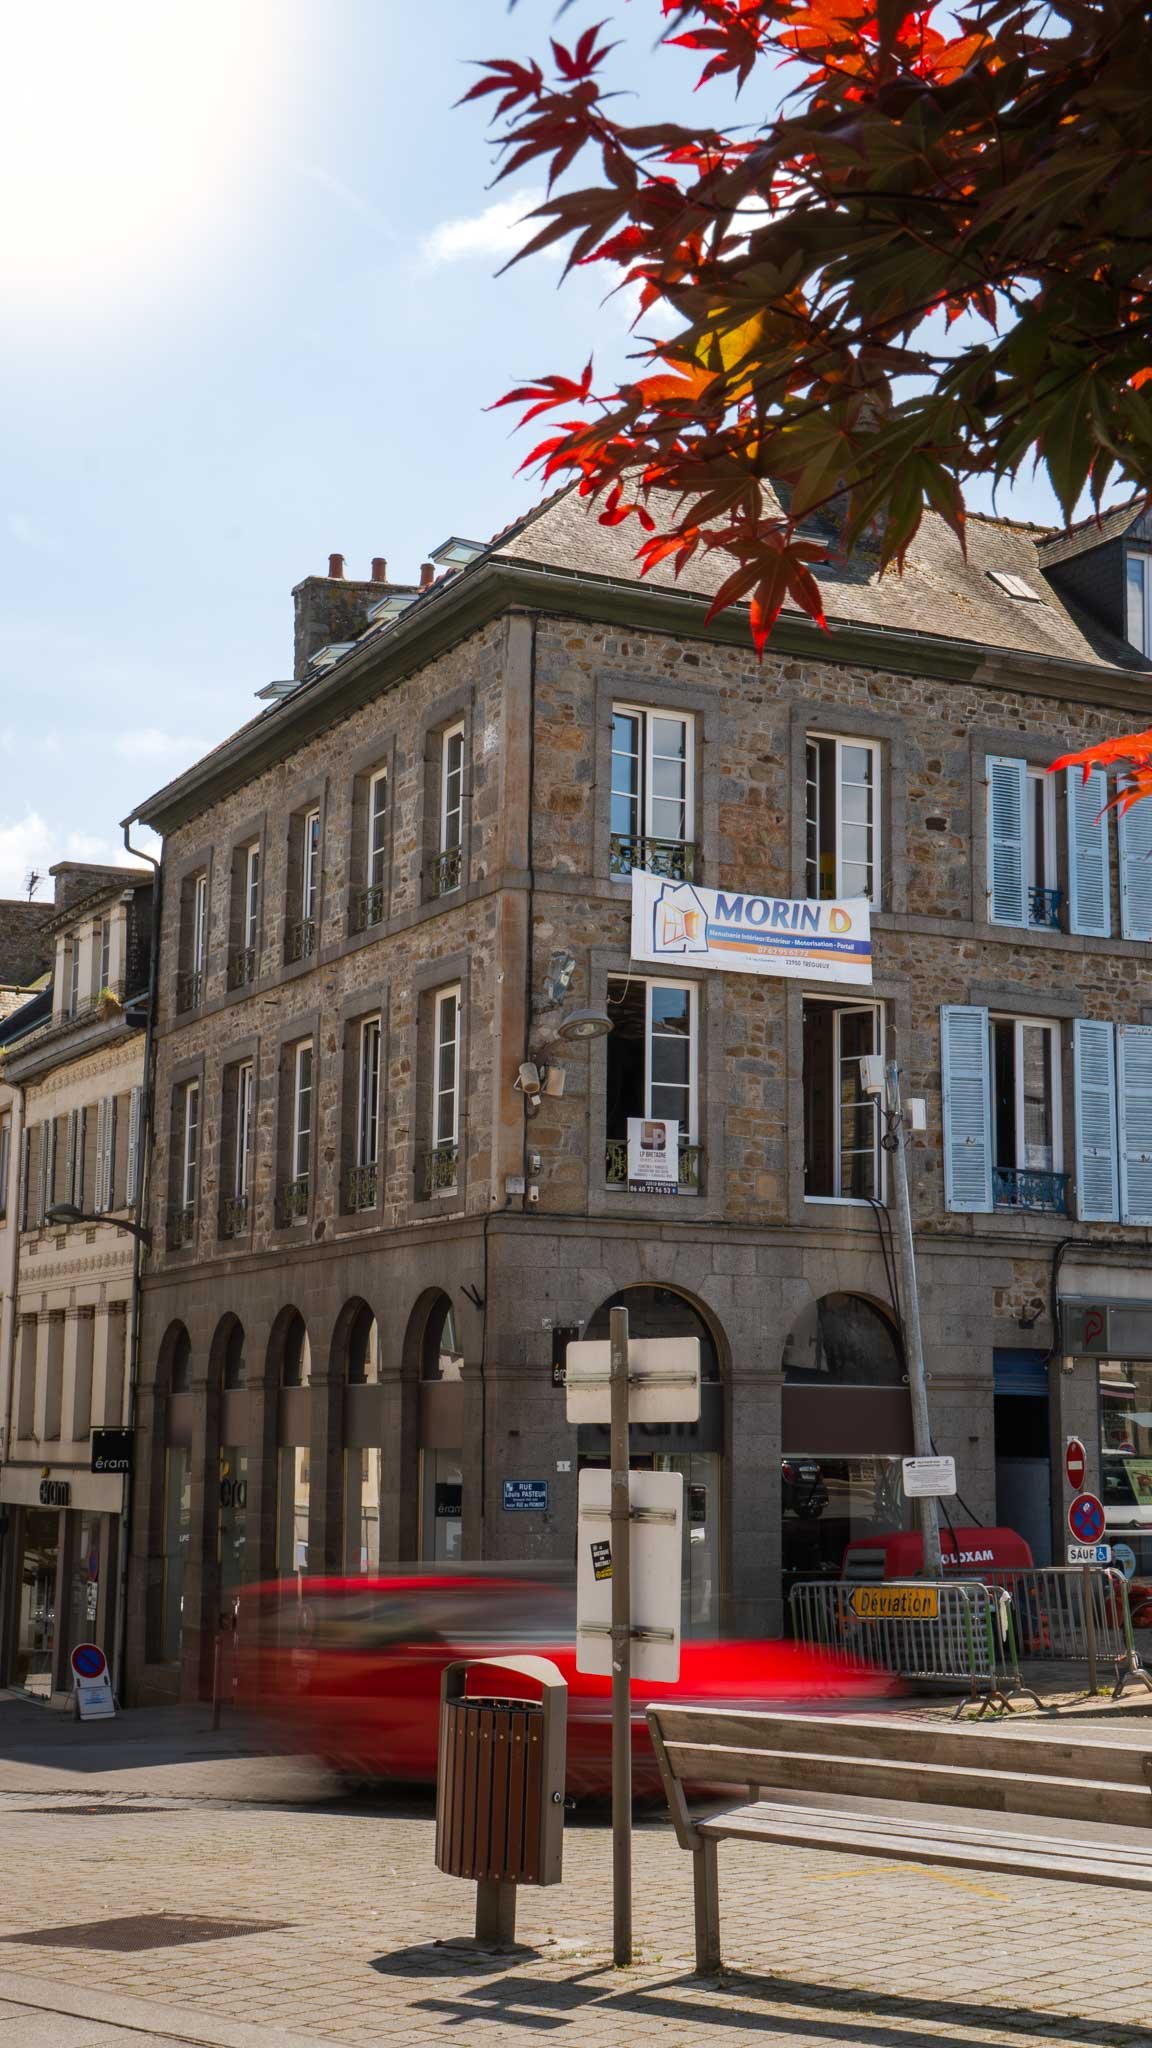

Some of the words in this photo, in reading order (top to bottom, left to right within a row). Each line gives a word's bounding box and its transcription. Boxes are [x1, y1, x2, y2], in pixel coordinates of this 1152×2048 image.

[715, 894, 821, 932] MORIN
[828, 907, 852, 934] D
[709, 929, 741, 941] Menuiserie
[794, 938, 834, 949] Motorisation
[837, 942, 855, 951] Portail
[553, 1362, 567, 1381] éra
[95, 1456, 129, 1469] éram
[505, 1490, 520, 1498] Louis
[521, 1490, 546, 1498] PASTEUR
[1070, 1547, 1095, 1560] SAUF
[860, 1590, 931, 1612] Déviation
